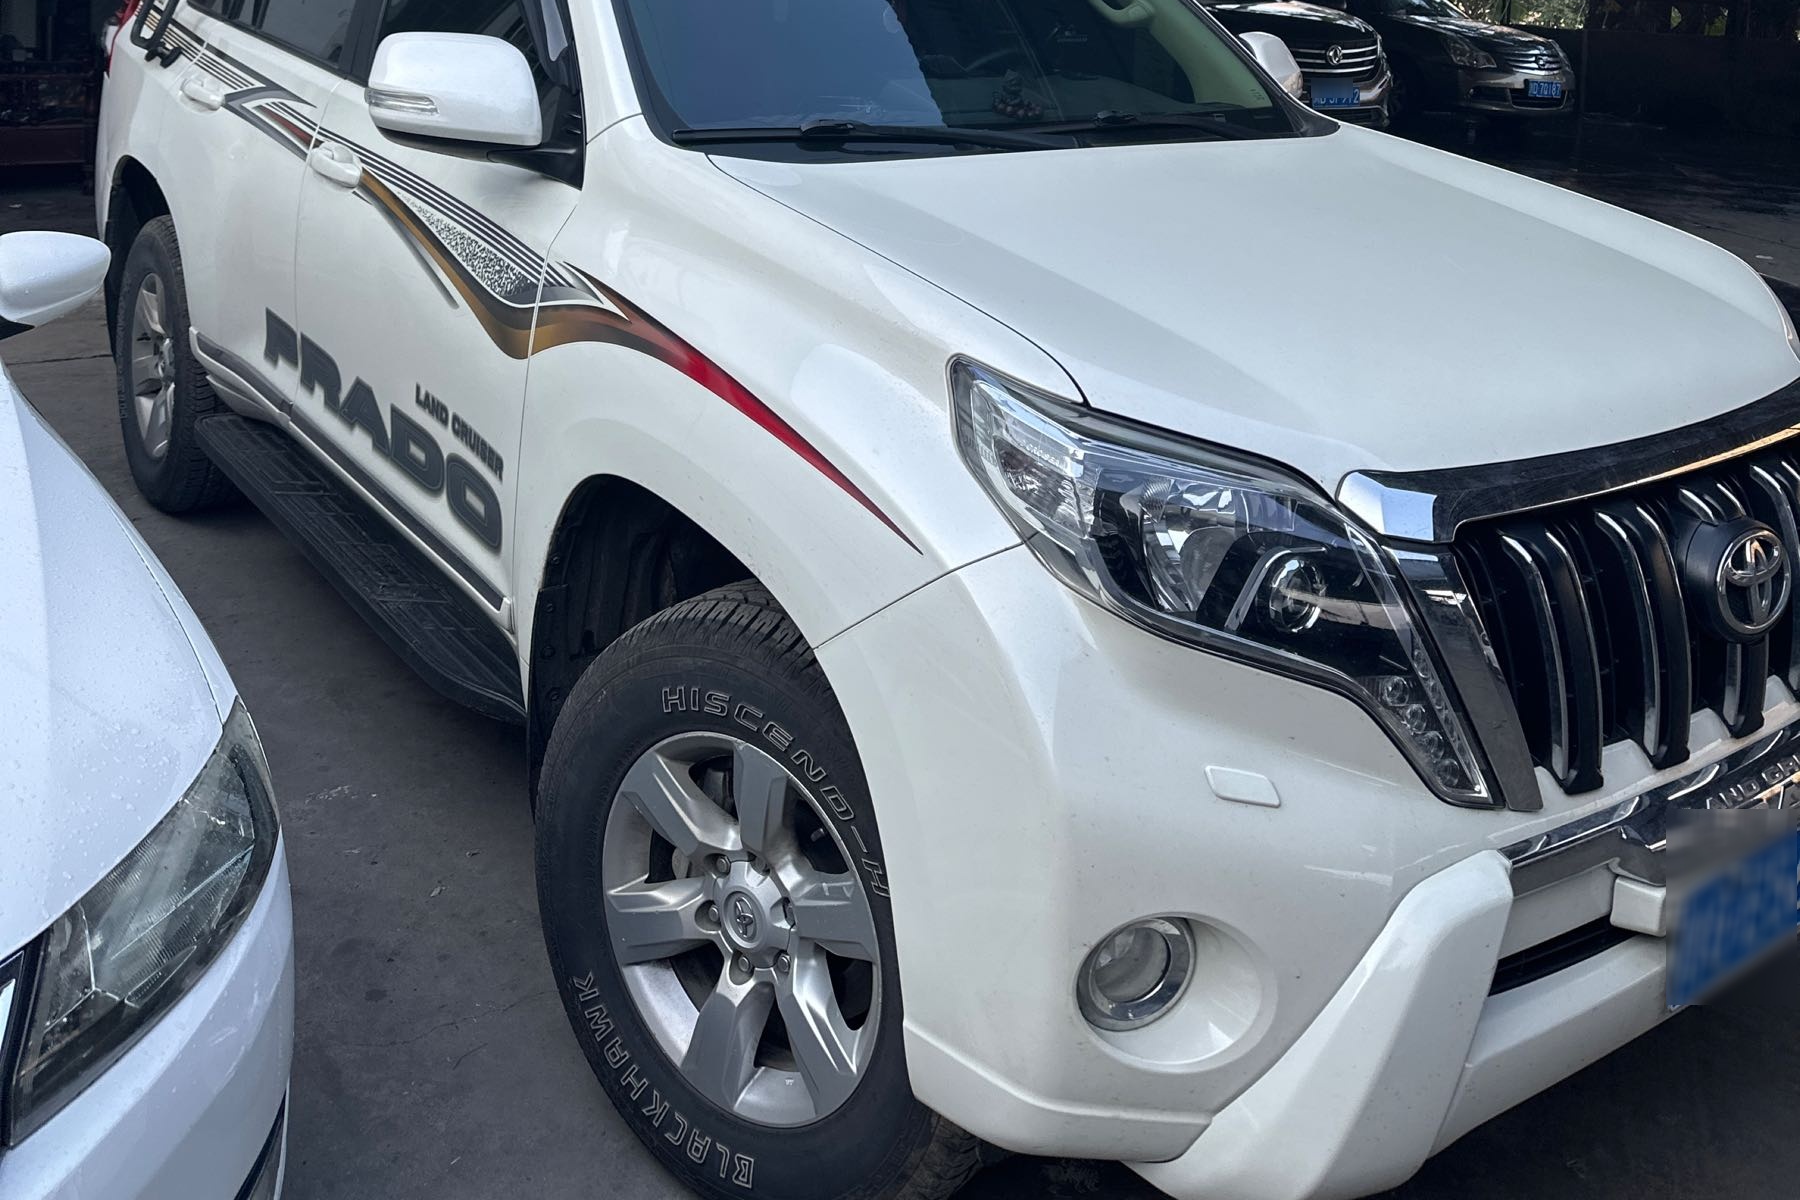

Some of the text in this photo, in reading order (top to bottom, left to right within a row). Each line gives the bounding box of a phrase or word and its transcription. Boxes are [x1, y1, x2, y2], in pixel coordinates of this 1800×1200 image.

[264, 306, 503, 555] PRADO
[415, 381, 504, 483] LAND CRUISER
